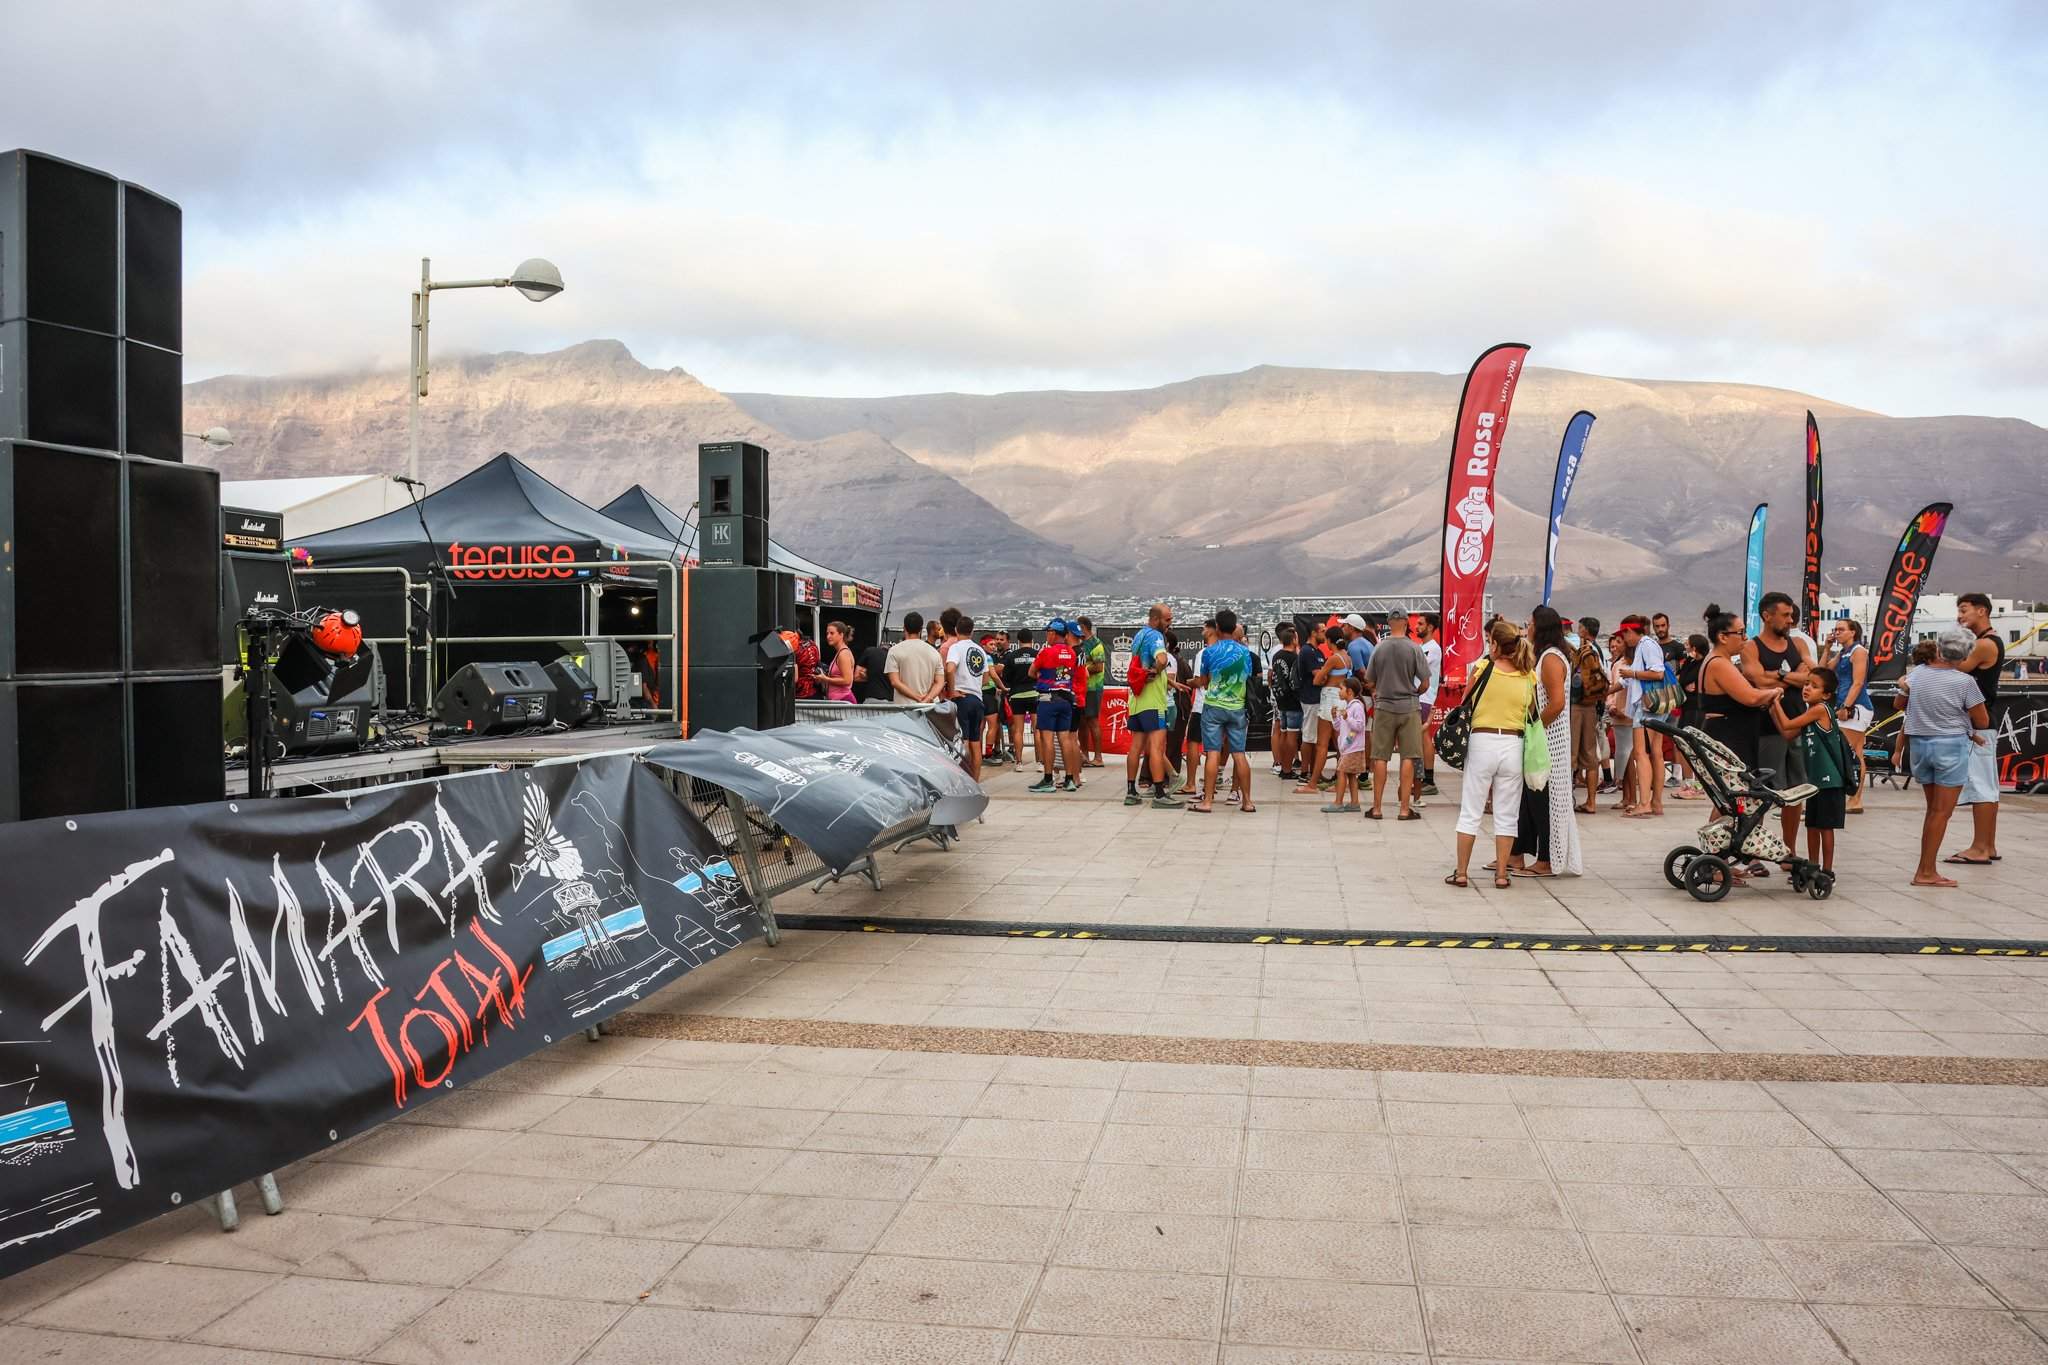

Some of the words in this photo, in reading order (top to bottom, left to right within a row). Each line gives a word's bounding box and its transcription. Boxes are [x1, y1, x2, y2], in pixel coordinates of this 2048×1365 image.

[1467, 411, 1496, 477] Rosa
[714, 525, 729, 540] HK
[1459, 486, 1490, 562] Santa
[23, 782, 503, 1190] FAMARA
